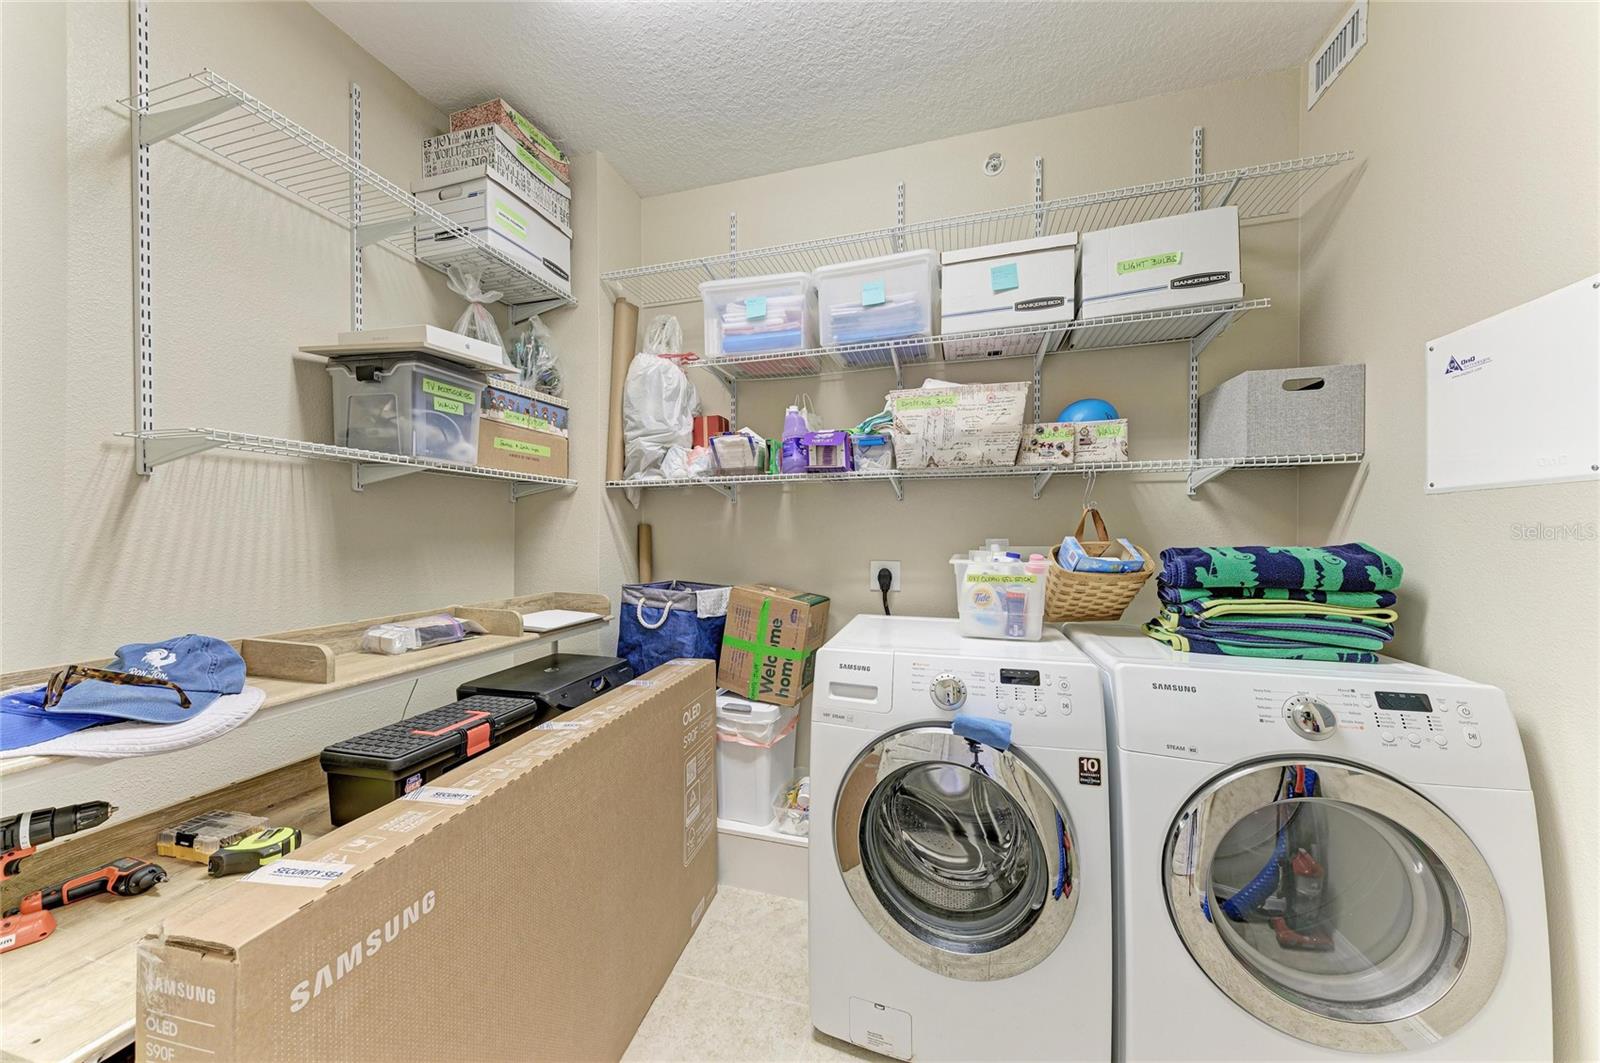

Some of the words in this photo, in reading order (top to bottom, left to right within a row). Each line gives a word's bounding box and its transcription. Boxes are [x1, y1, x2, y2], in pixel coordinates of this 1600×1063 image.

[463, 126, 494, 140] WARM
[1123, 259, 1148, 271] LIGHT
[1151, 254, 1178, 266] BULBS
[1174, 277, 1209, 287] BANKERS
[1210, 274, 1227, 282] BOX
[1017, 301, 1047, 309] BANKERS
[425, 381, 436, 391] TV
[975, 592, 992, 603] Tide
[759, 618, 783, 694] Welcme
[839, 663, 871, 672] SAMSUNG
[1152, 682, 1197, 693] SAMSUNG
[683, 703, 700, 726] OLED
[1081, 758, 1099, 772] 10
[274, 866, 320, 877] SECURITY
[289, 890, 437, 1014] SAMSUNG
[145, 1016, 179, 1037] OLED
[145, 1042, 175, 1062] S90F
